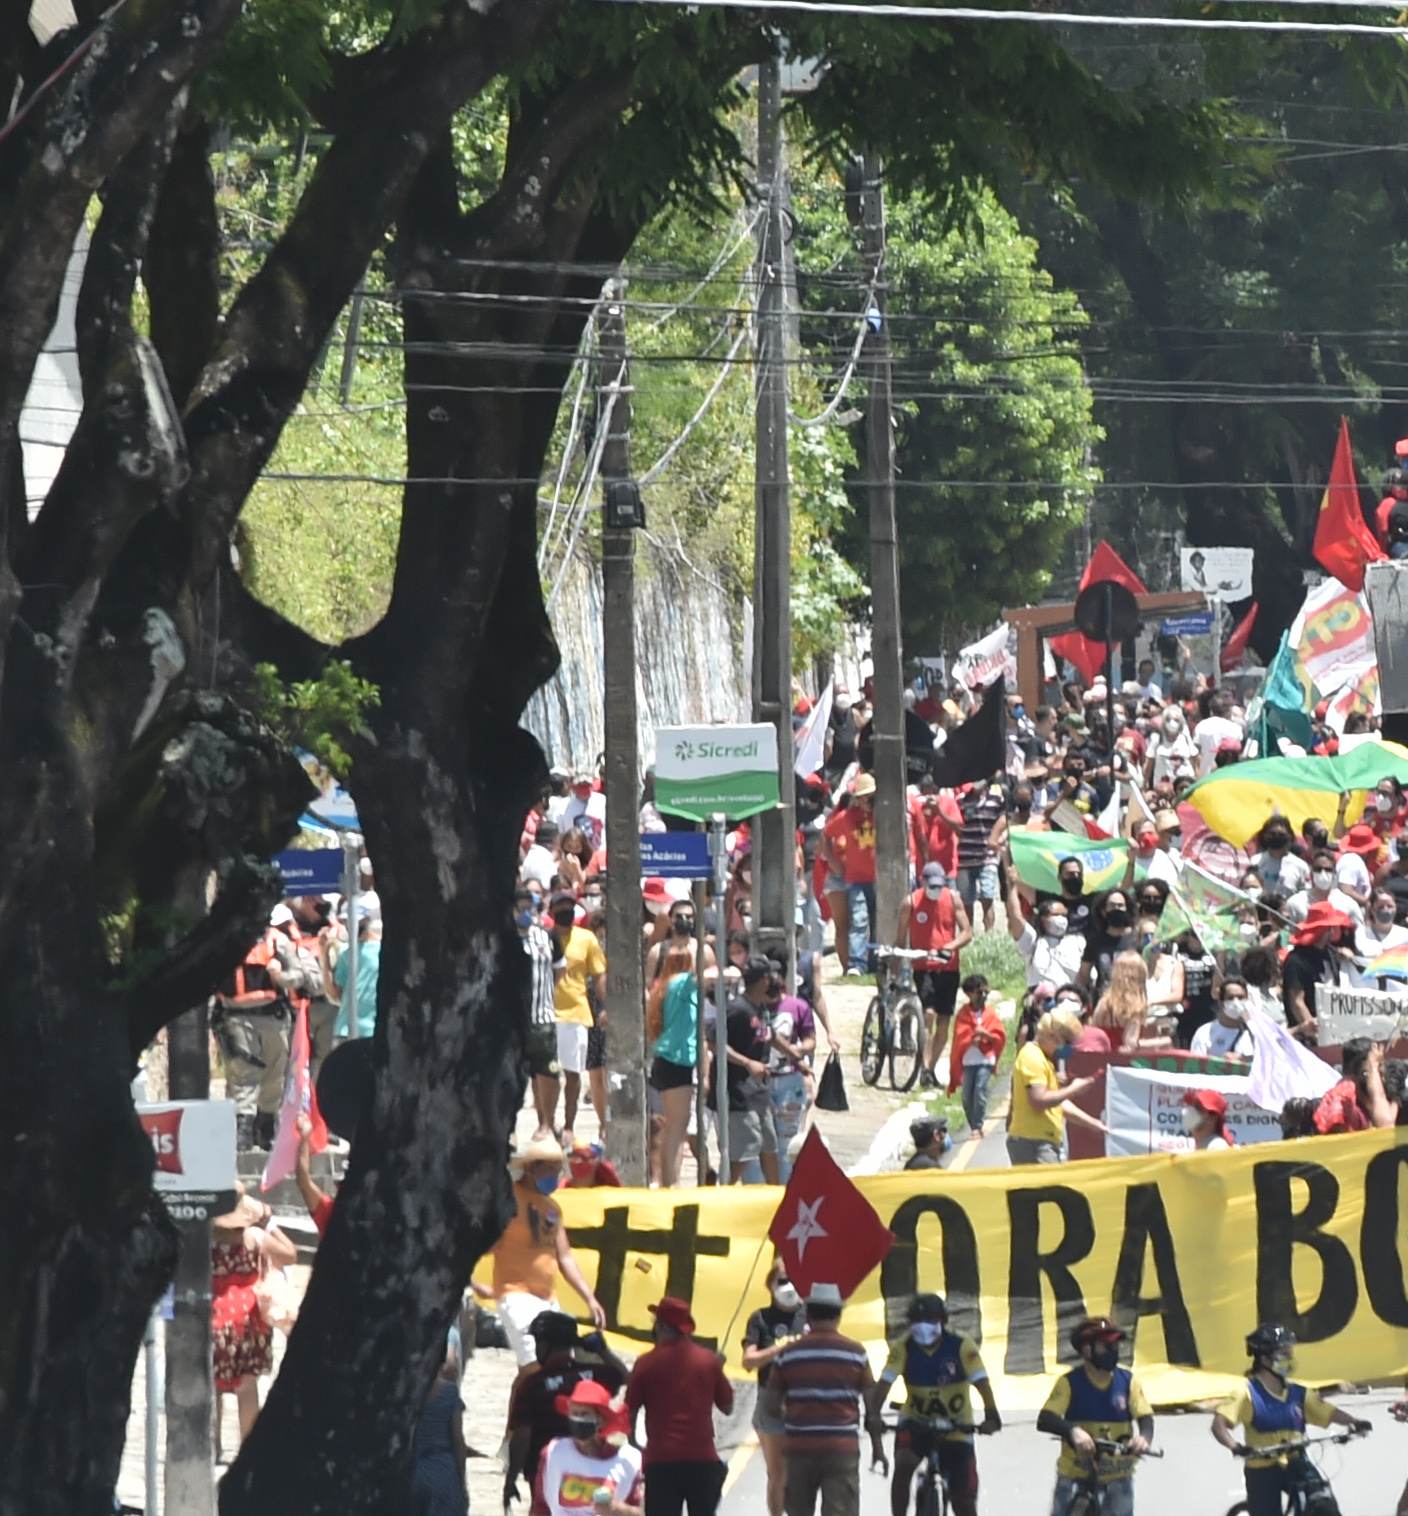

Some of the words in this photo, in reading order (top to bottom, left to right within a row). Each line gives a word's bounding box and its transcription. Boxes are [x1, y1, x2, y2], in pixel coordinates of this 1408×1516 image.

[697, 740, 759, 758] Sicredi
[1247, 1115, 1282, 1125] DIGN
[152, 1125, 174, 1153] is
[562, 1181, 1201, 1376] #ORA
[911, 1389, 965, 1417] NÃO
